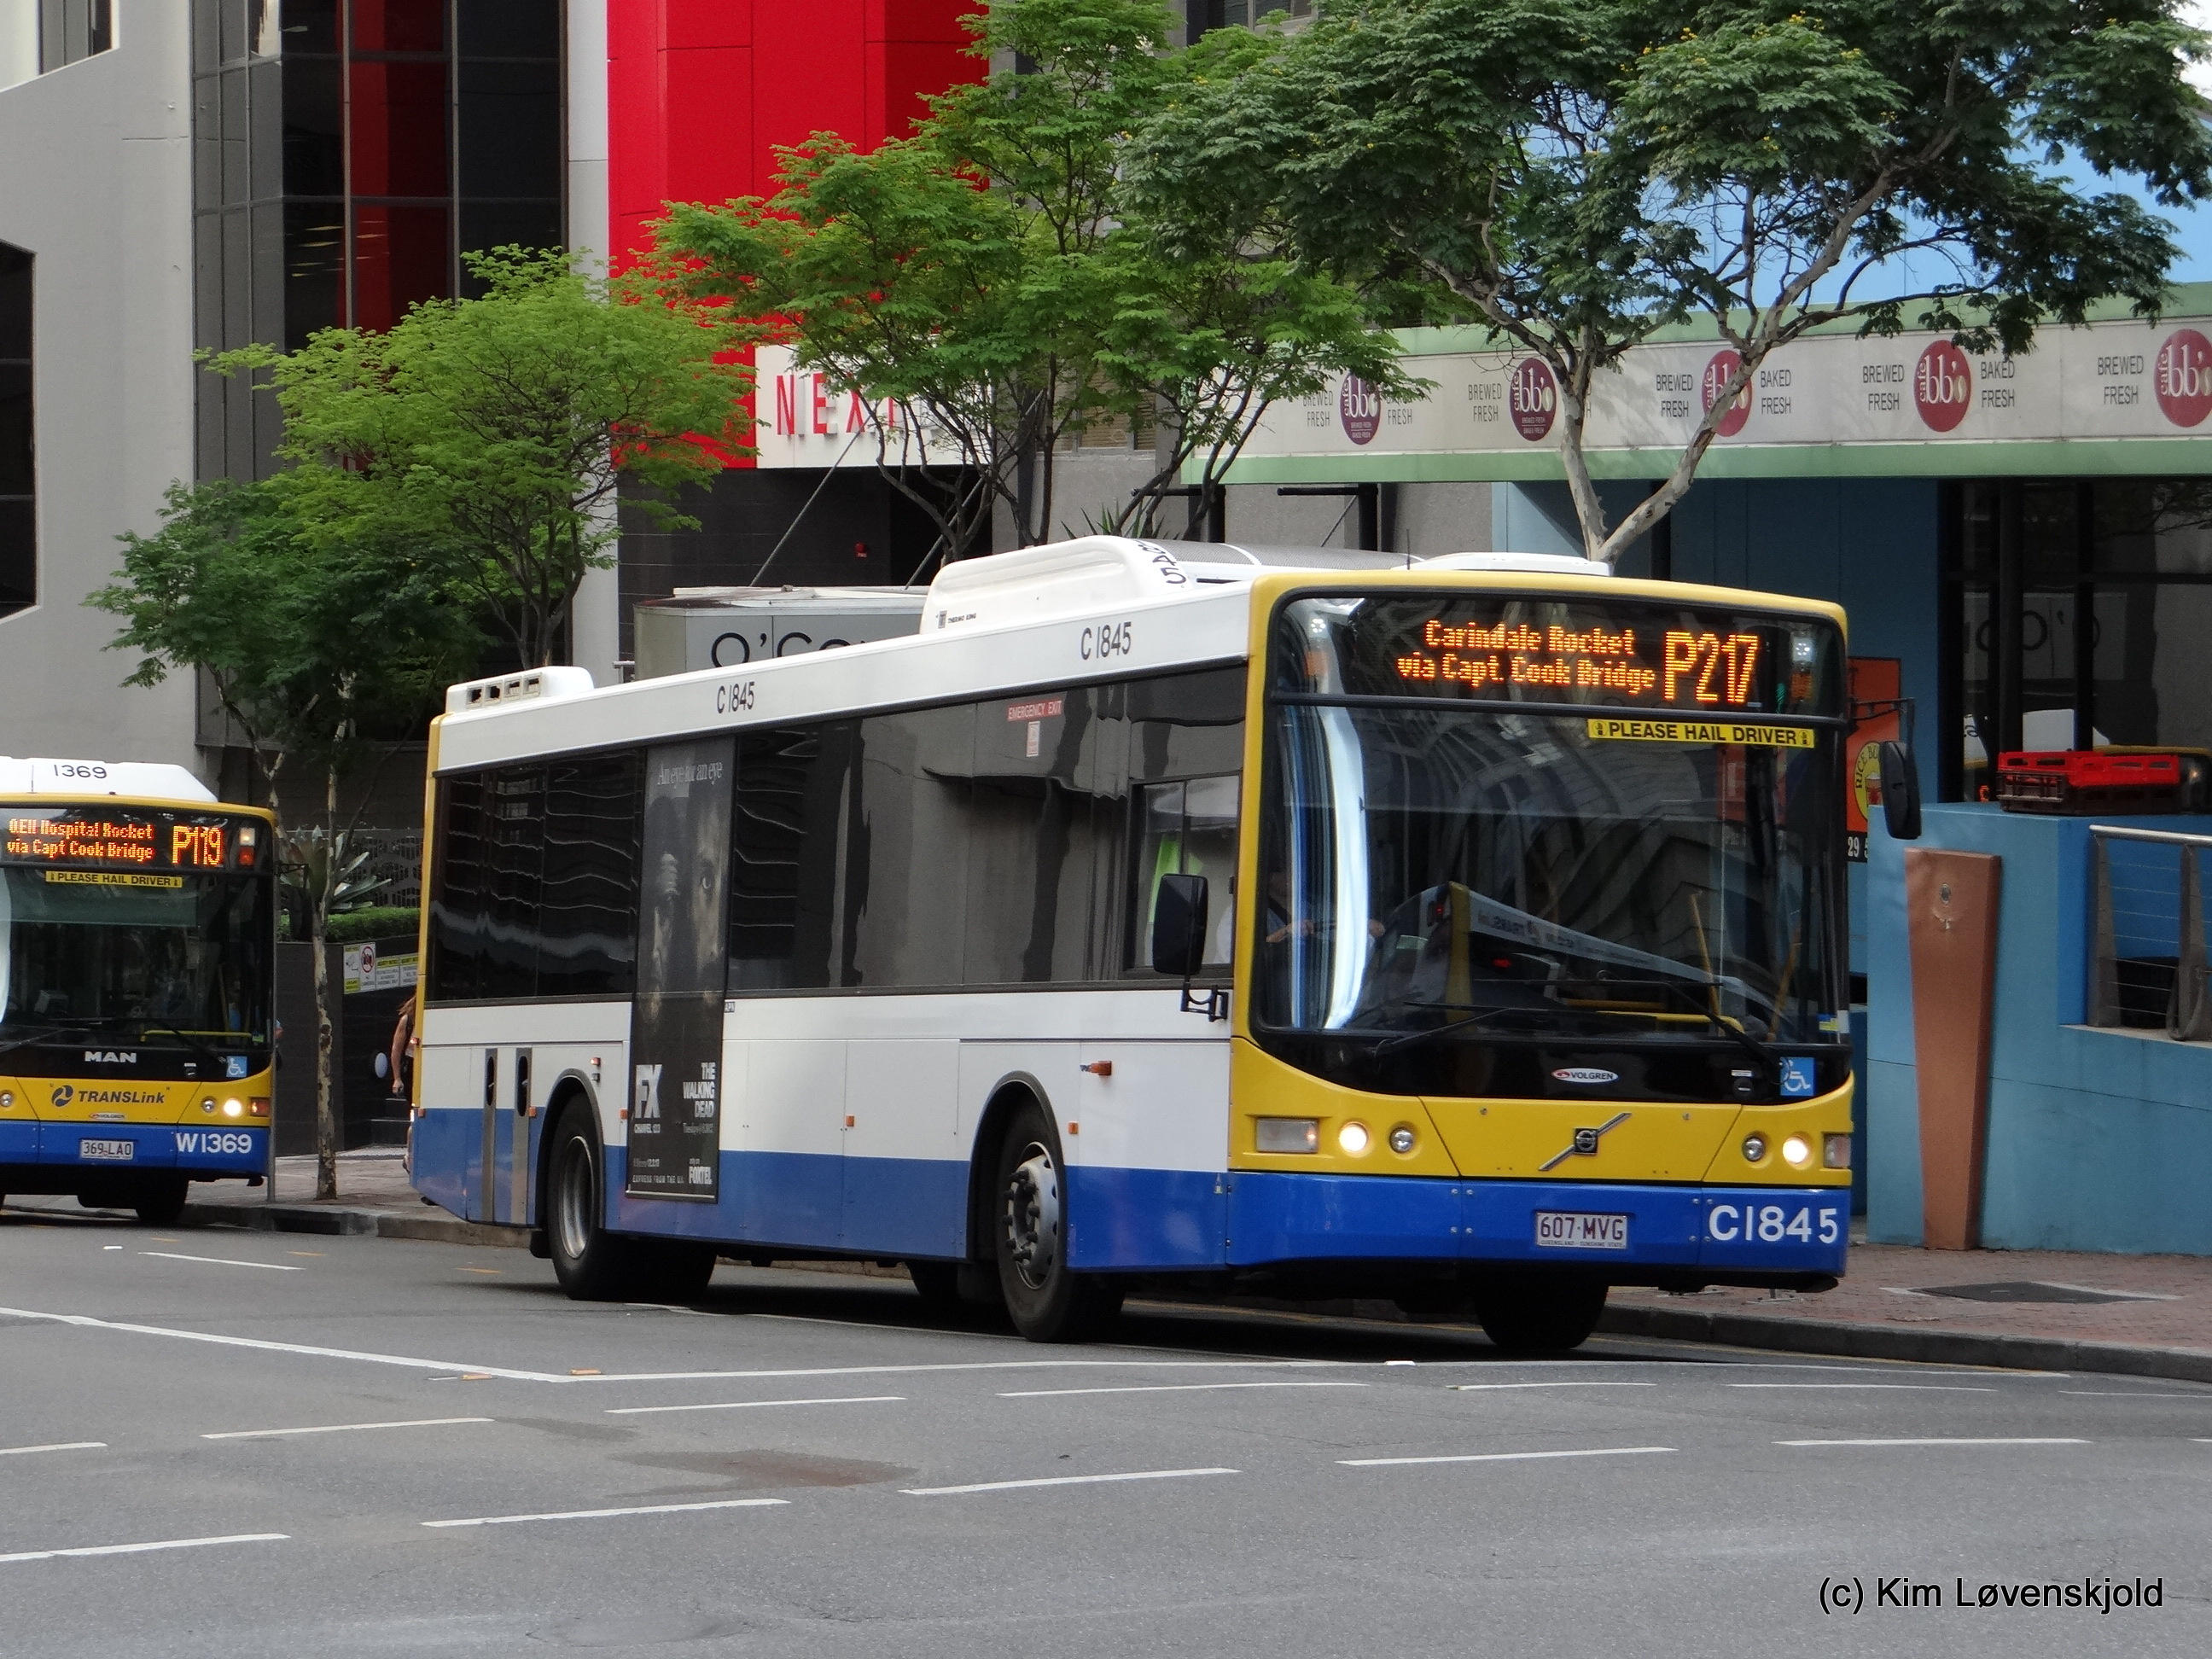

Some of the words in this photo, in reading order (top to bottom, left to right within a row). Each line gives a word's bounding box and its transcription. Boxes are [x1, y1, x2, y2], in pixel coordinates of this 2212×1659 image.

[1862, 364, 1905, 383] BREWED
[1980, 360, 2016, 380] BAKED
[2098, 355, 2144, 375] BREWED
[1656, 374, 1693, 392] BREWED
[1760, 370, 1791, 388] BAKED
[1302, 390, 1333, 407] BREWED
[1468, 383, 1502, 400] BREWED
[1982, 389, 2015, 409] FRESH
[2104, 386, 2139, 405] FRESH
[1661, 400, 1689, 418] FRESH
[1761, 397, 1791, 415] FRESH
[1868, 392, 1900, 411] FRESH
[1307, 410, 1330, 427] FRESH
[1387, 409, 1413, 426] FRESH
[1473, 405, 1499, 422] FRESH
[1080, 621, 1132, 660] C1845
[1424, 620, 1542, 651] Carindale
[1548, 625, 1635, 655] Rocket
[1397, 652, 1435, 679] via
[1510, 656, 1570, 684] Cook
[1577, 660, 1656, 695] Bridge
[1663, 631, 1759, 702] P217
[717, 681, 754, 713] C1845
[1008, 702, 1045, 720] EMERGENCY
[1047, 700, 1062, 715] EXIT
[1608, 721, 1678, 740] PLEASE
[1685, 725, 1726, 742] HAIL
[1732, 726, 1797, 746] DRIVER
[54, 764, 107, 779] 1369
[40, 819, 99, 840] Hospital
[103, 822, 154, 840] Rocket
[7, 839, 29, 853] via
[32, 840, 66, 858] Capt
[69, 841, 104, 857] Cook
[108, 842, 154, 862] Bridge
[172, 825, 221, 864] P119
[58, 872, 98, 882] PLEASE
[102, 875, 127, 884] HAIL
[131, 876, 171, 886] DRIVER
[84, 1051, 137, 1063] MAN
[701, 1062, 716, 1080] THE
[1570, 1070, 1614, 1080] VOLGREN
[79, 1091, 166, 1104] TRANSLink
[634, 1063, 663, 1119] FX
[683, 1081, 715, 1099] WALKING
[694, 1100, 715, 1118] DEAD
[175, 1133, 253, 1154] W1369
[688, 1166, 713, 1185] FOXTEL
[1708, 1205, 1837, 1244] C1845
